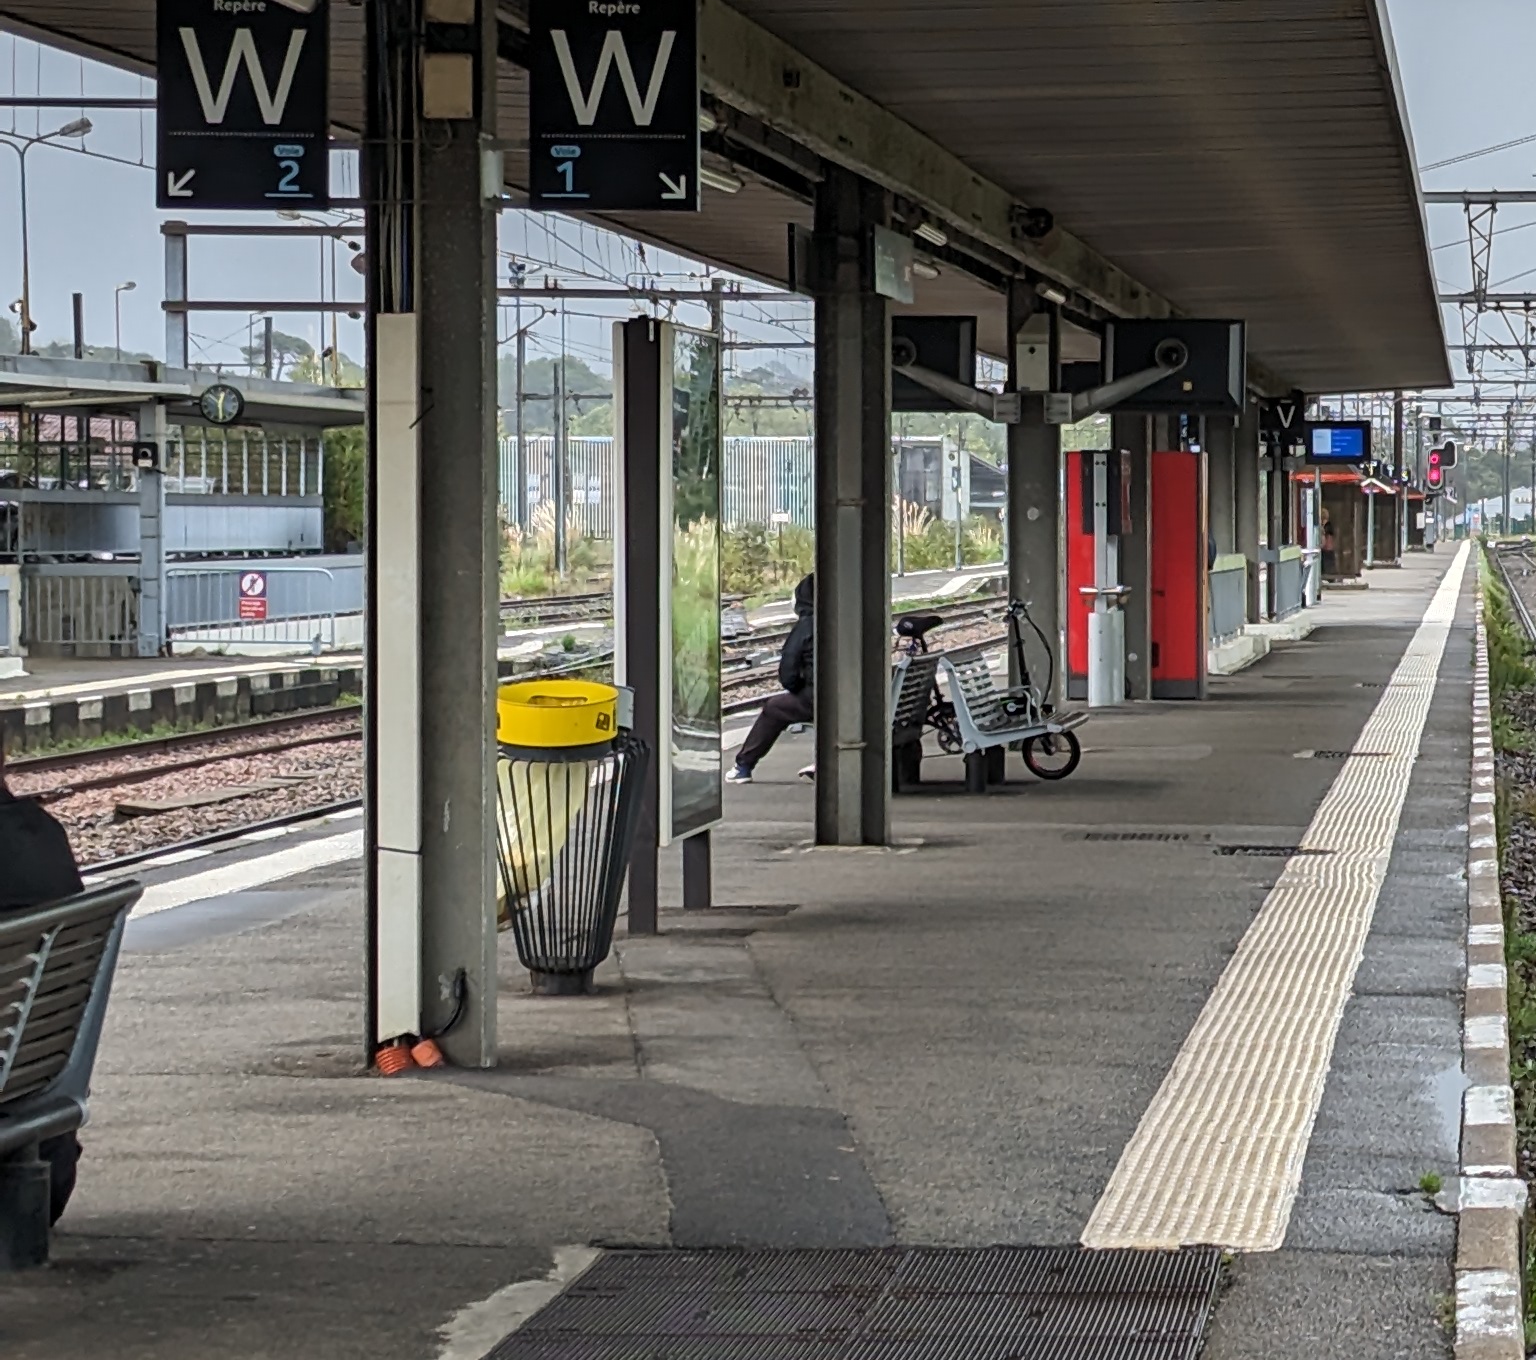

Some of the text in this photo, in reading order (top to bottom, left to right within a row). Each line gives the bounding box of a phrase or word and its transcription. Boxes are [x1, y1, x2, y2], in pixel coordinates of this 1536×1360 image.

[588, 0, 641, 18] Repère
[178, 27, 308, 125] W
[549, 29, 678, 126] W
[278, 160, 300, 192] 2
[556, 161, 574, 192] 1
[1277, 405, 1296, 428] V
